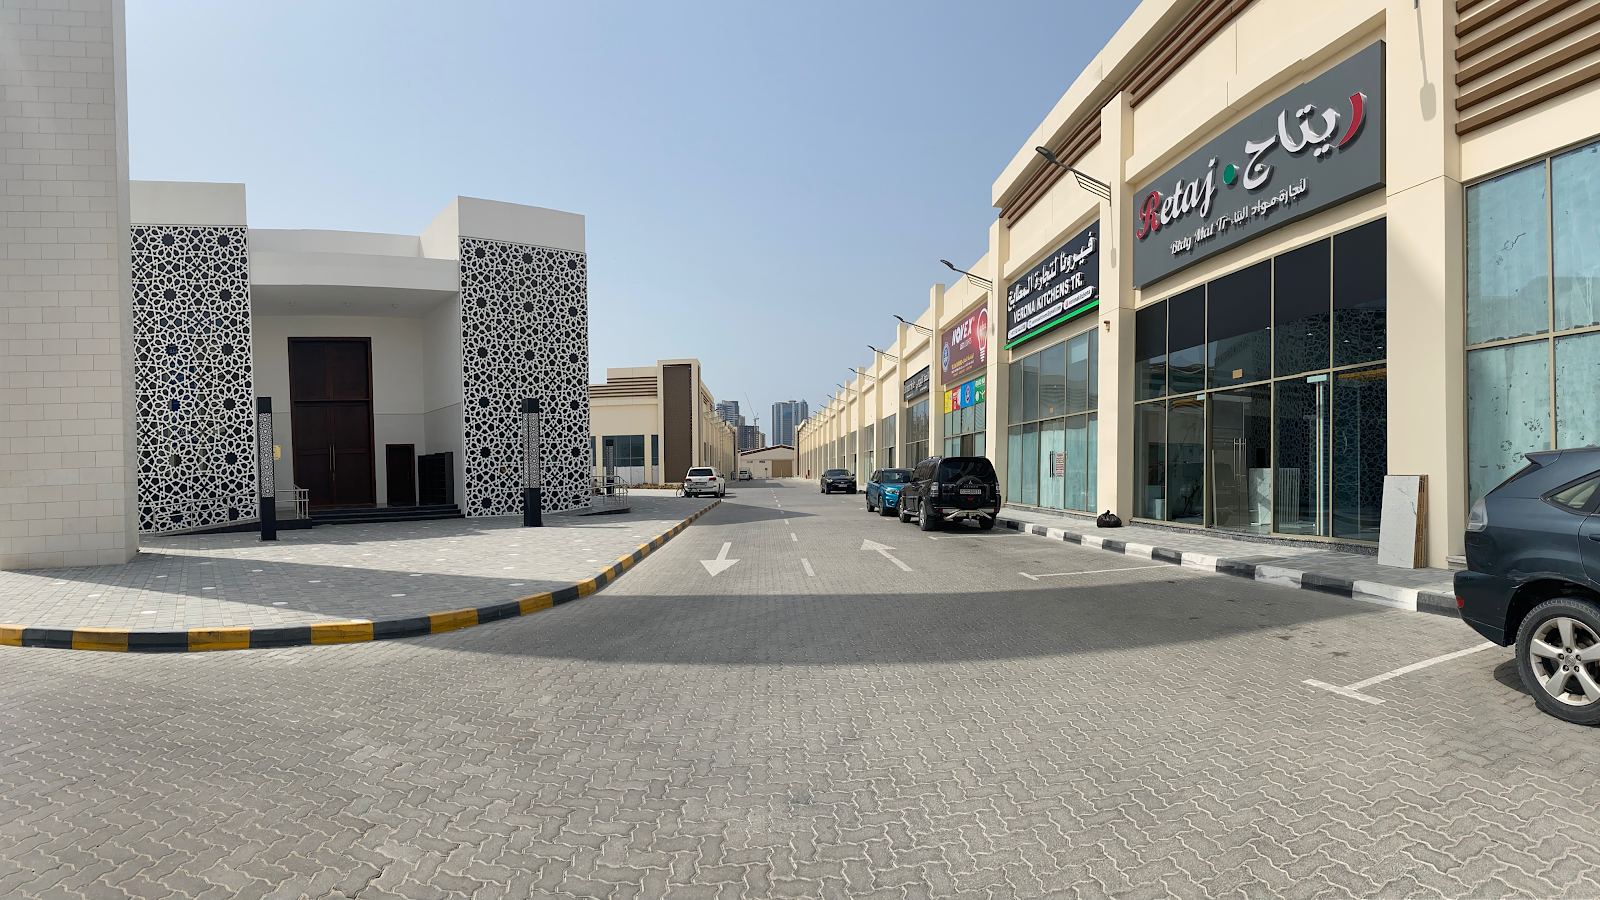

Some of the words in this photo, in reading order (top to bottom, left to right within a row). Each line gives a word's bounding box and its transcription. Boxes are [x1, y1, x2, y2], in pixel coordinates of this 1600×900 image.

[1243, 92, 1367, 190] ريتاج
[1136, 155, 1218, 239] Retaj
[1251, 196, 1280, 216] مواد
[1278, 177, 1307, 204] لتجارة
[1060, 231, 1097, 273] فيرونا
[1170, 235, 1192, 254] Bldg
[1194, 223, 1214, 243] Mat
[1034, 256, 1060, 289] لتجارة
[1013, 300, 1036, 323] VERONA
[1036, 279, 1071, 310] KITCHENS
[951, 317, 973, 346] NOVEX
